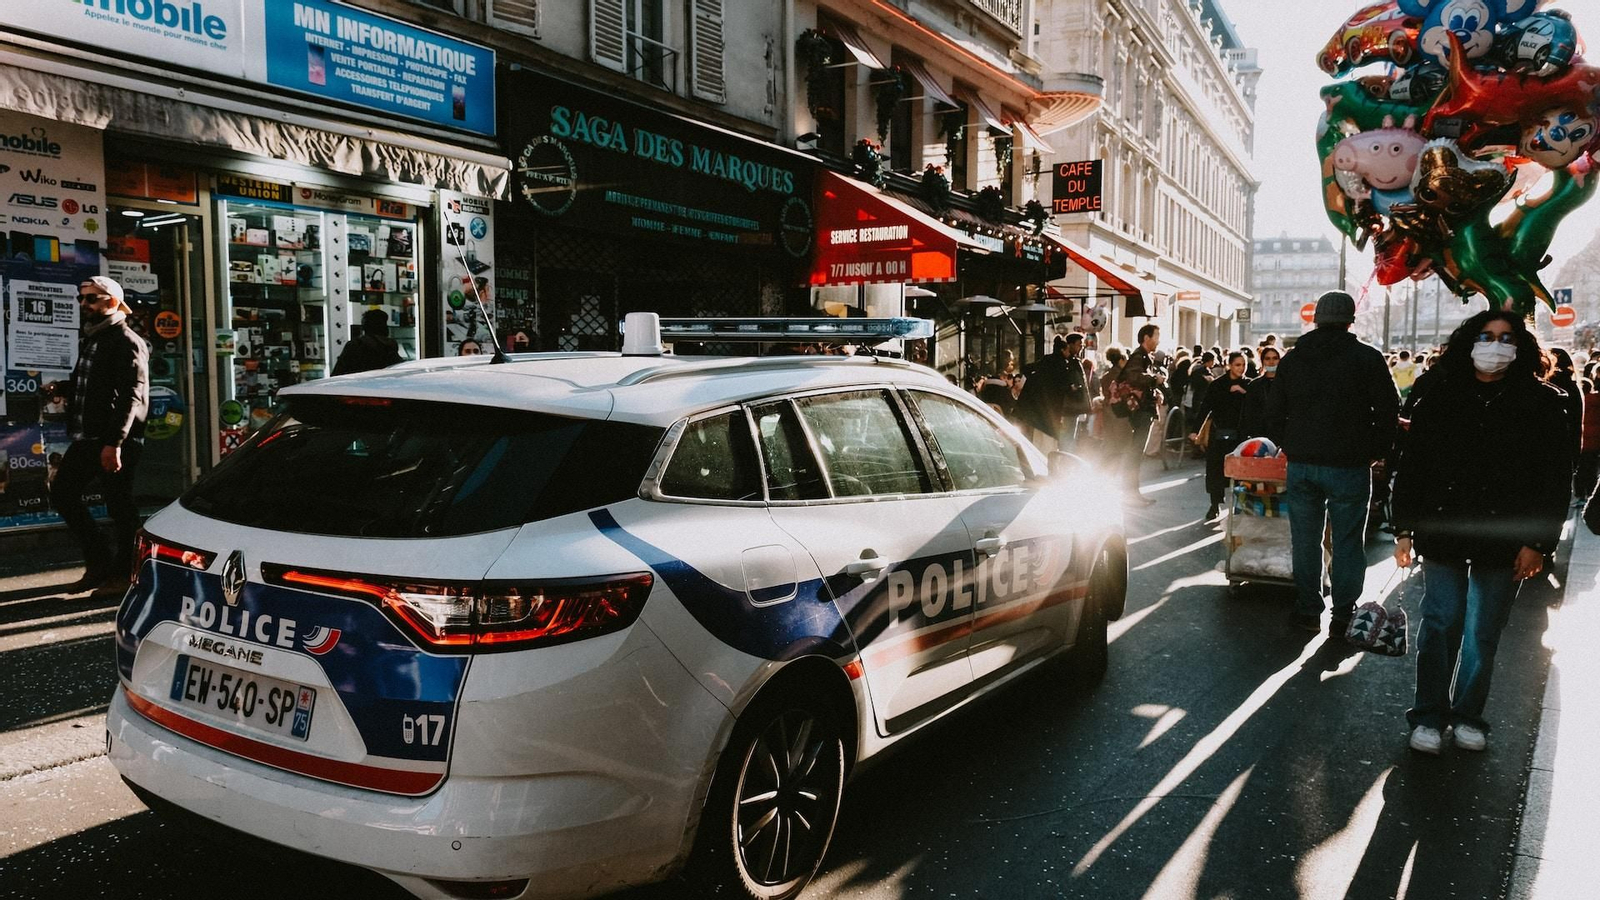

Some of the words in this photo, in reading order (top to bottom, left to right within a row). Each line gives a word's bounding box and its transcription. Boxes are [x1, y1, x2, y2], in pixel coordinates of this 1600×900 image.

[84, 9, 119, 25] Appelez
[122, 18, 130, 26] le
[132, 22, 161, 34] monde
[163, 30, 182, 40] pour
[184, 35, 207, 46] moins
[209, 41, 227, 50] cher
[294, 3, 330, 35] MN
[337, 15, 476, 76] INFORMATIQUE
[1520, 41, 1538, 49] POLICE
[305, 32, 344, 51] INTERNET
[352, 45, 398, 66] IMPRESSION
[405, 60, 448, 79] PHOTOCOPIE
[454, 74, 467, 84] FAX
[331, 52, 356, 67] VENTE
[357, 60, 396, 78] PORTABLE
[402, 71, 445, 91] REPARATION
[335, 67, 387, 88] ACCESSOIRES
[388, 80, 444, 103] TELEPHONIQUES
[351, 83, 395, 102] TRANSFERT
[396, 94, 431, 111] D'ARGENT
[550, 105, 629, 154] SAGA
[633, 127, 685, 168] DES
[689, 144, 794, 195] MARQUES
[19, 169, 57, 186] Wiko
[1060, 162, 1093, 177] CAFE
[220, 176, 280, 191] WESTERN
[1068, 180, 1086, 193] DU
[7, 193, 58, 208] ASUS
[239, 187, 280, 200] UNION
[314, 192, 361, 206] MoneyGram
[463, 197, 488, 207] MOBILE
[82, 204, 98, 214] LG
[1053, 195, 1101, 212] TEMPLE
[12, 216, 50, 227] NOKIA
[830, 228, 858, 244] SERVICE
[859, 225, 909, 242] RESTAURATION
[831, 264, 844, 278] 7/7
[876, 261, 882, 276] A
[900, 260, 906, 275] H
[31, 300, 46, 314] 16
[6, 379, 37, 393] 360
[19, 498, 41, 507] Lyca
[888, 546, 1029, 629] POLICE
[179, 595, 297, 648] POLICE
[189, 634, 264, 666] MEGANE
[185, 664, 295, 727] EW-540-SP
[294, 712, 308, 731] 75
[415, 714, 446, 746] 17
